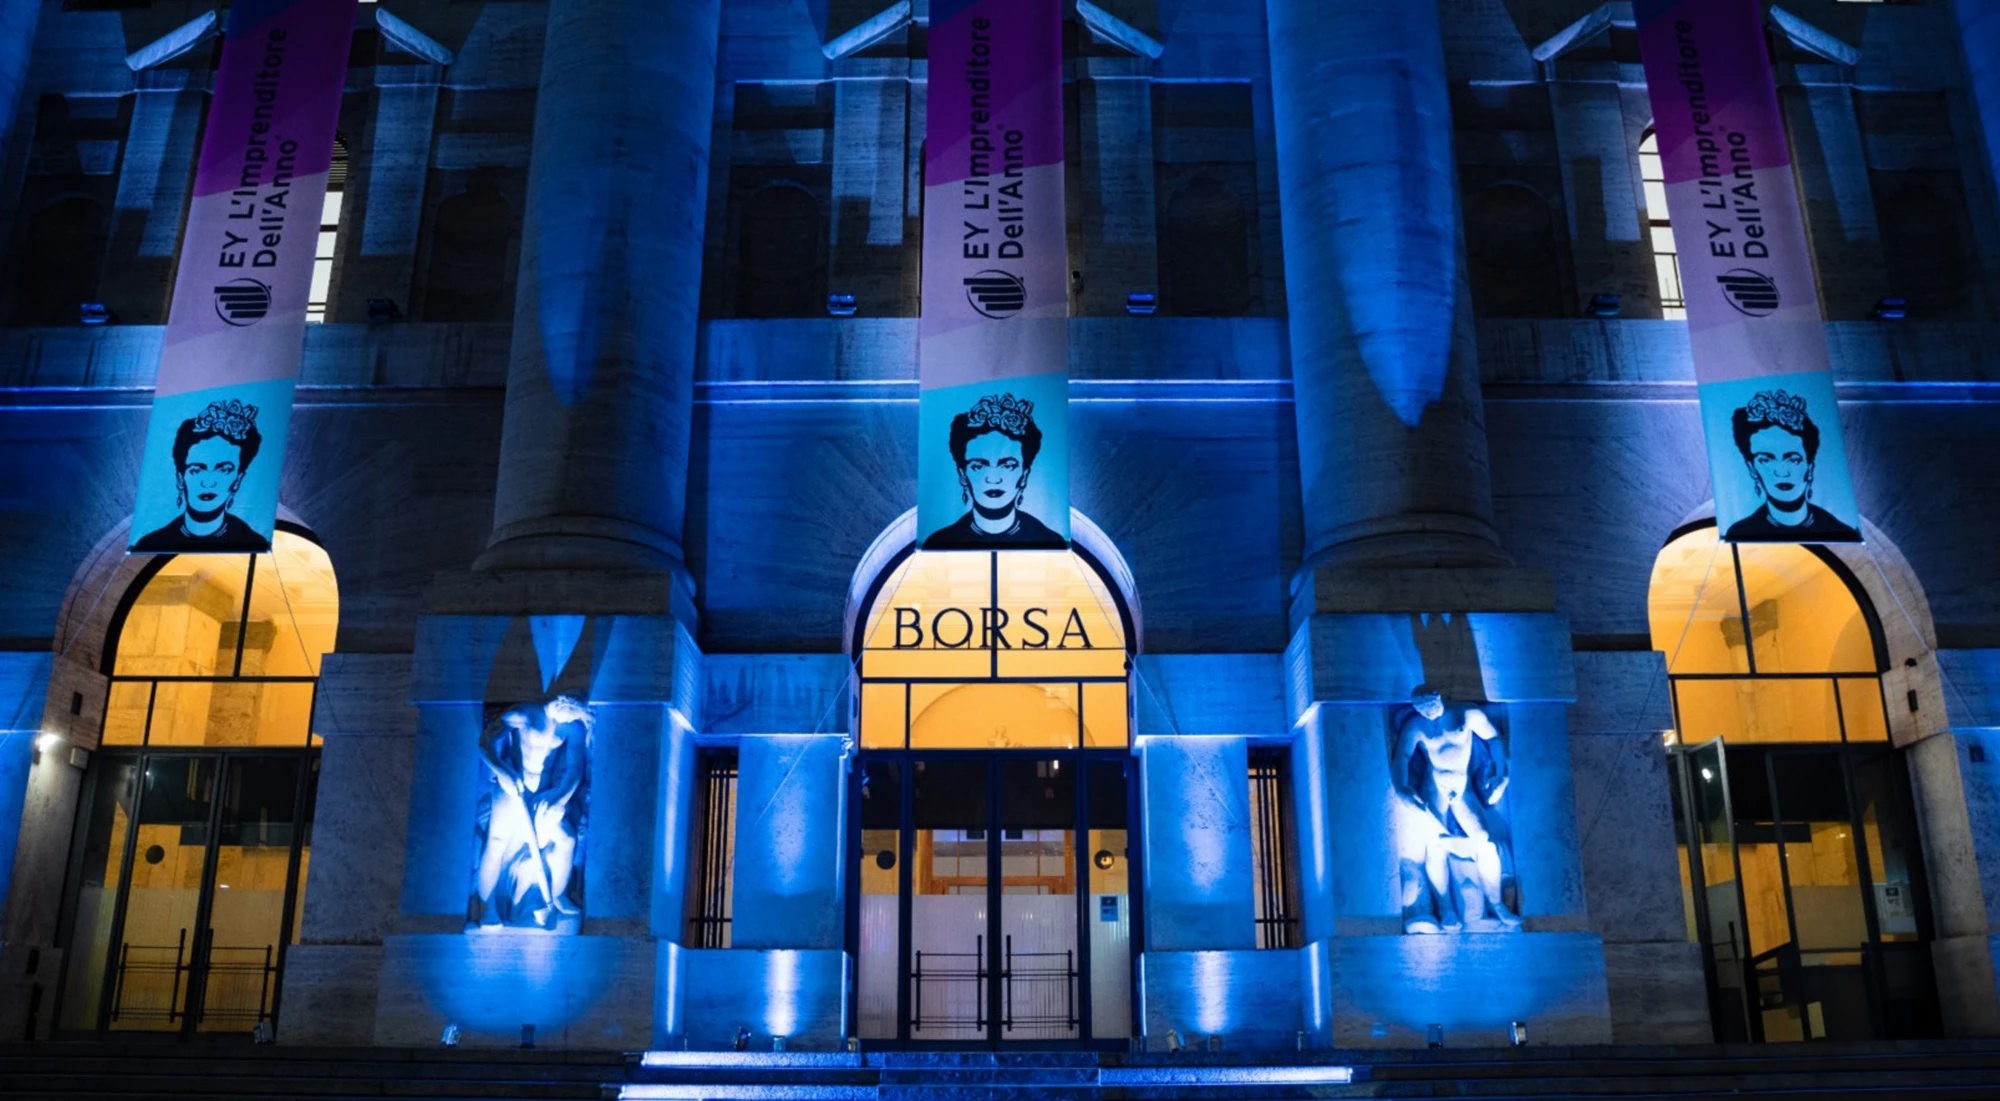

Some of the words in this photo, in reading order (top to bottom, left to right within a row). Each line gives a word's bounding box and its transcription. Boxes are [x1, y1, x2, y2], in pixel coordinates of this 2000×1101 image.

[228, 28, 288, 220] L'Imprenditore
[964, 17, 995, 210] L'Imprenditore
[1674, 19, 1727, 210] L'Imprenditore
[218, 231, 249, 268] EY
[963, 221, 990, 259] EY
[1706, 220, 1737, 259] EY
[892, 607, 1094, 650] BORSA
